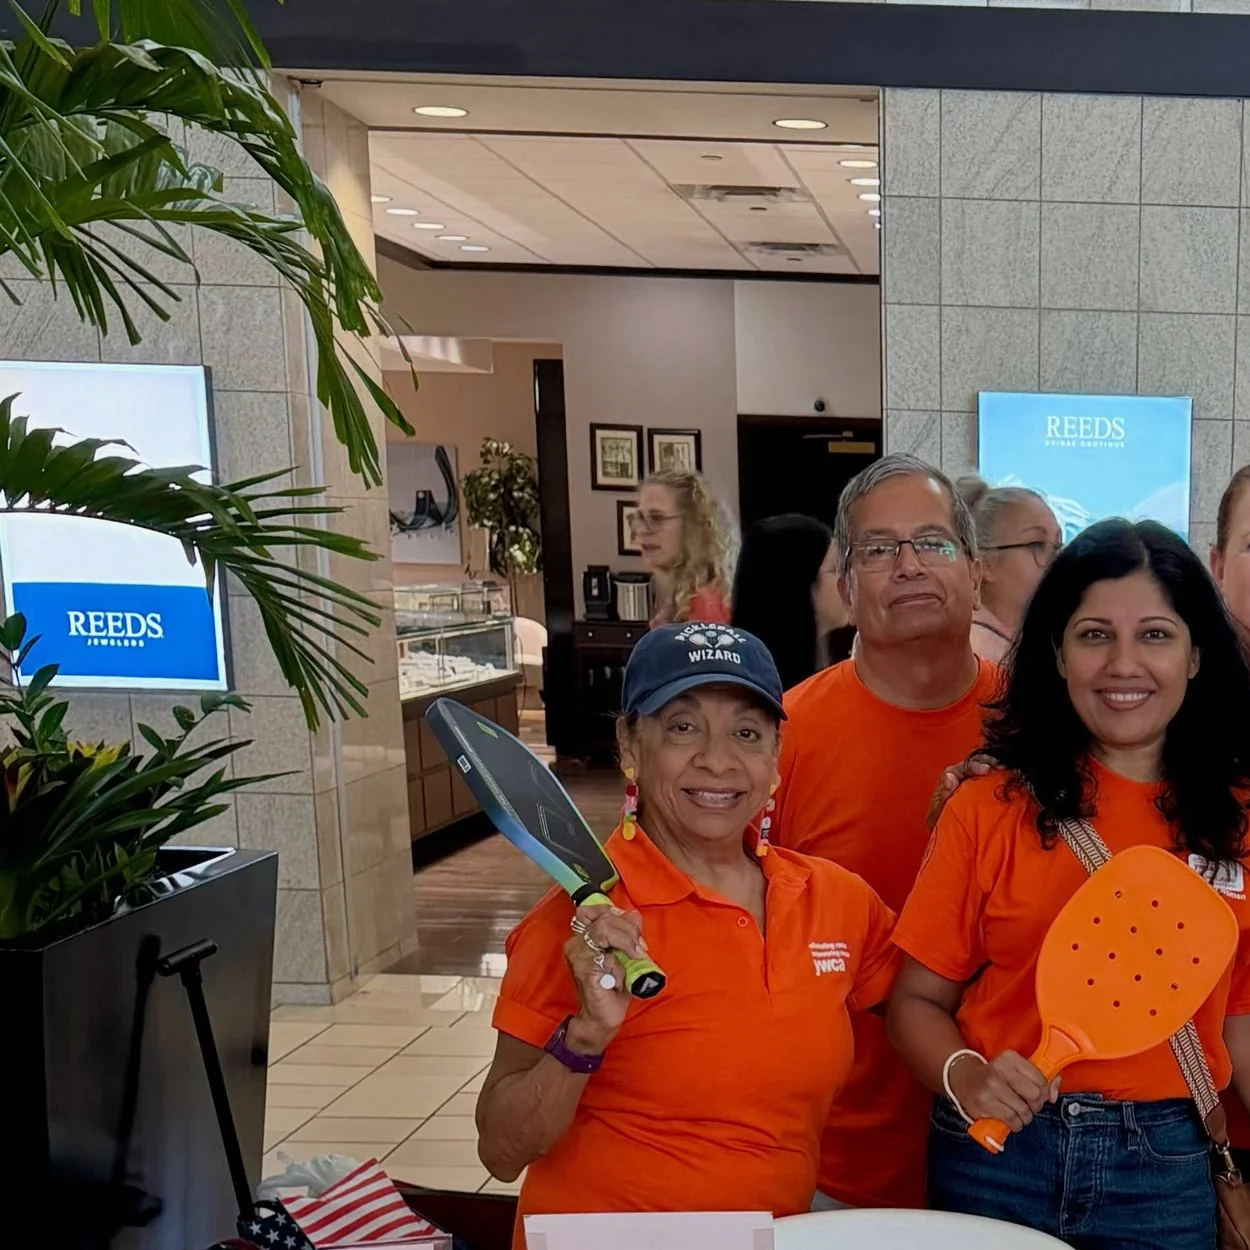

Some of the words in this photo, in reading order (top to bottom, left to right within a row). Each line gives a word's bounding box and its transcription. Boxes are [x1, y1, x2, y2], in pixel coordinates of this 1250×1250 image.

[1046, 415, 1125, 440] REEDS
[67, 611, 164, 638] REEDS
[674, 623, 747, 644] PICKLEBALL
[688, 649, 741, 665] WIZARD
[813, 958, 845, 976] ywca
